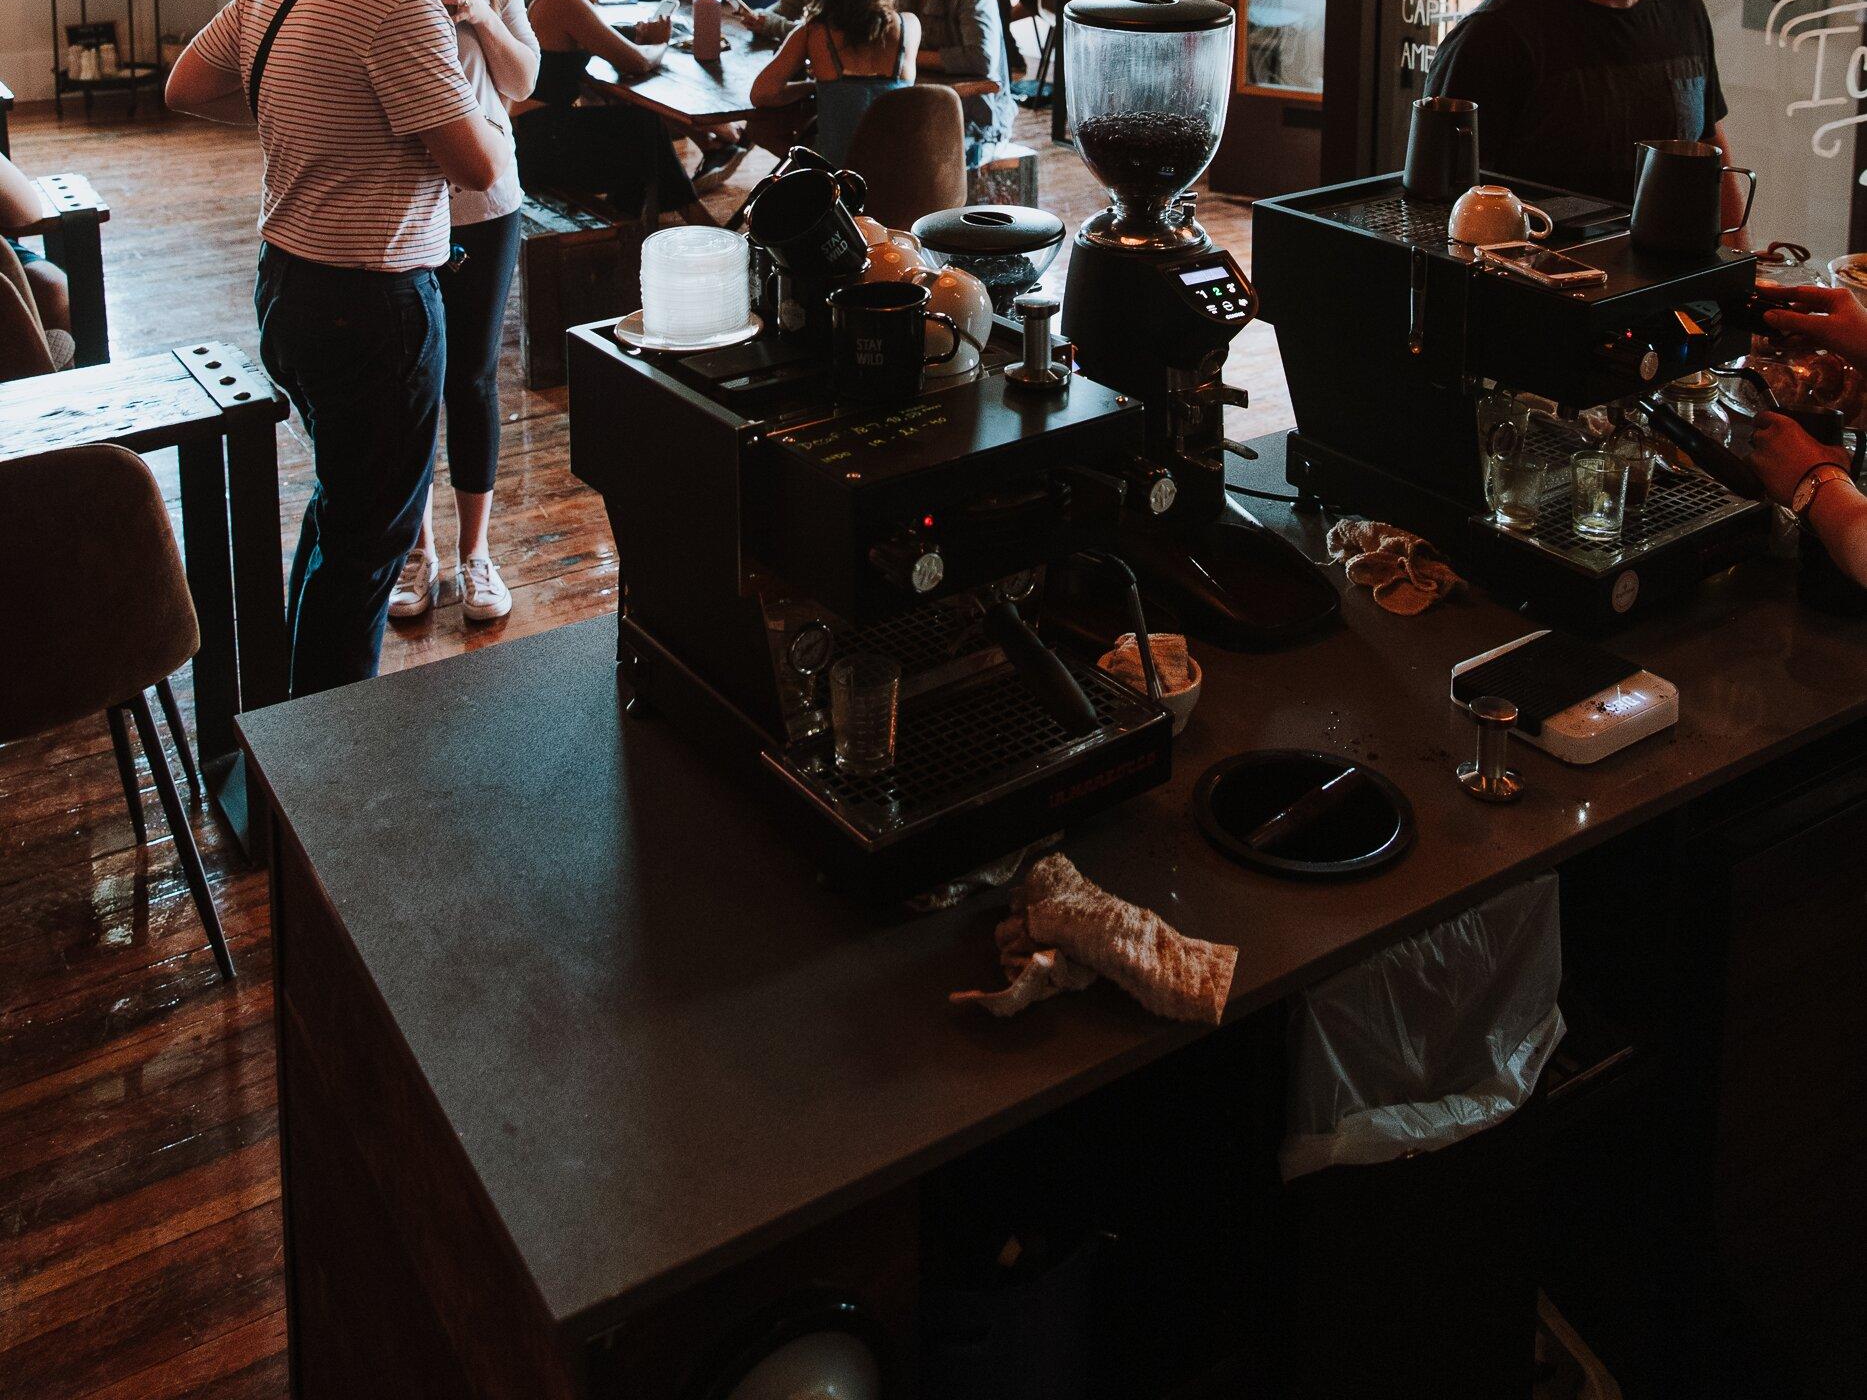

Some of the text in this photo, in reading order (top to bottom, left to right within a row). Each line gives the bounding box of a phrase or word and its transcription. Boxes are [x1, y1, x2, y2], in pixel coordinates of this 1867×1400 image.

[821, 230, 842, 255] STAY
[825, 240, 848, 263] WILD
[1212, 286, 1223, 297] 2
[856, 338, 882, 352] STAY
[856, 352, 884, 366] WILD
